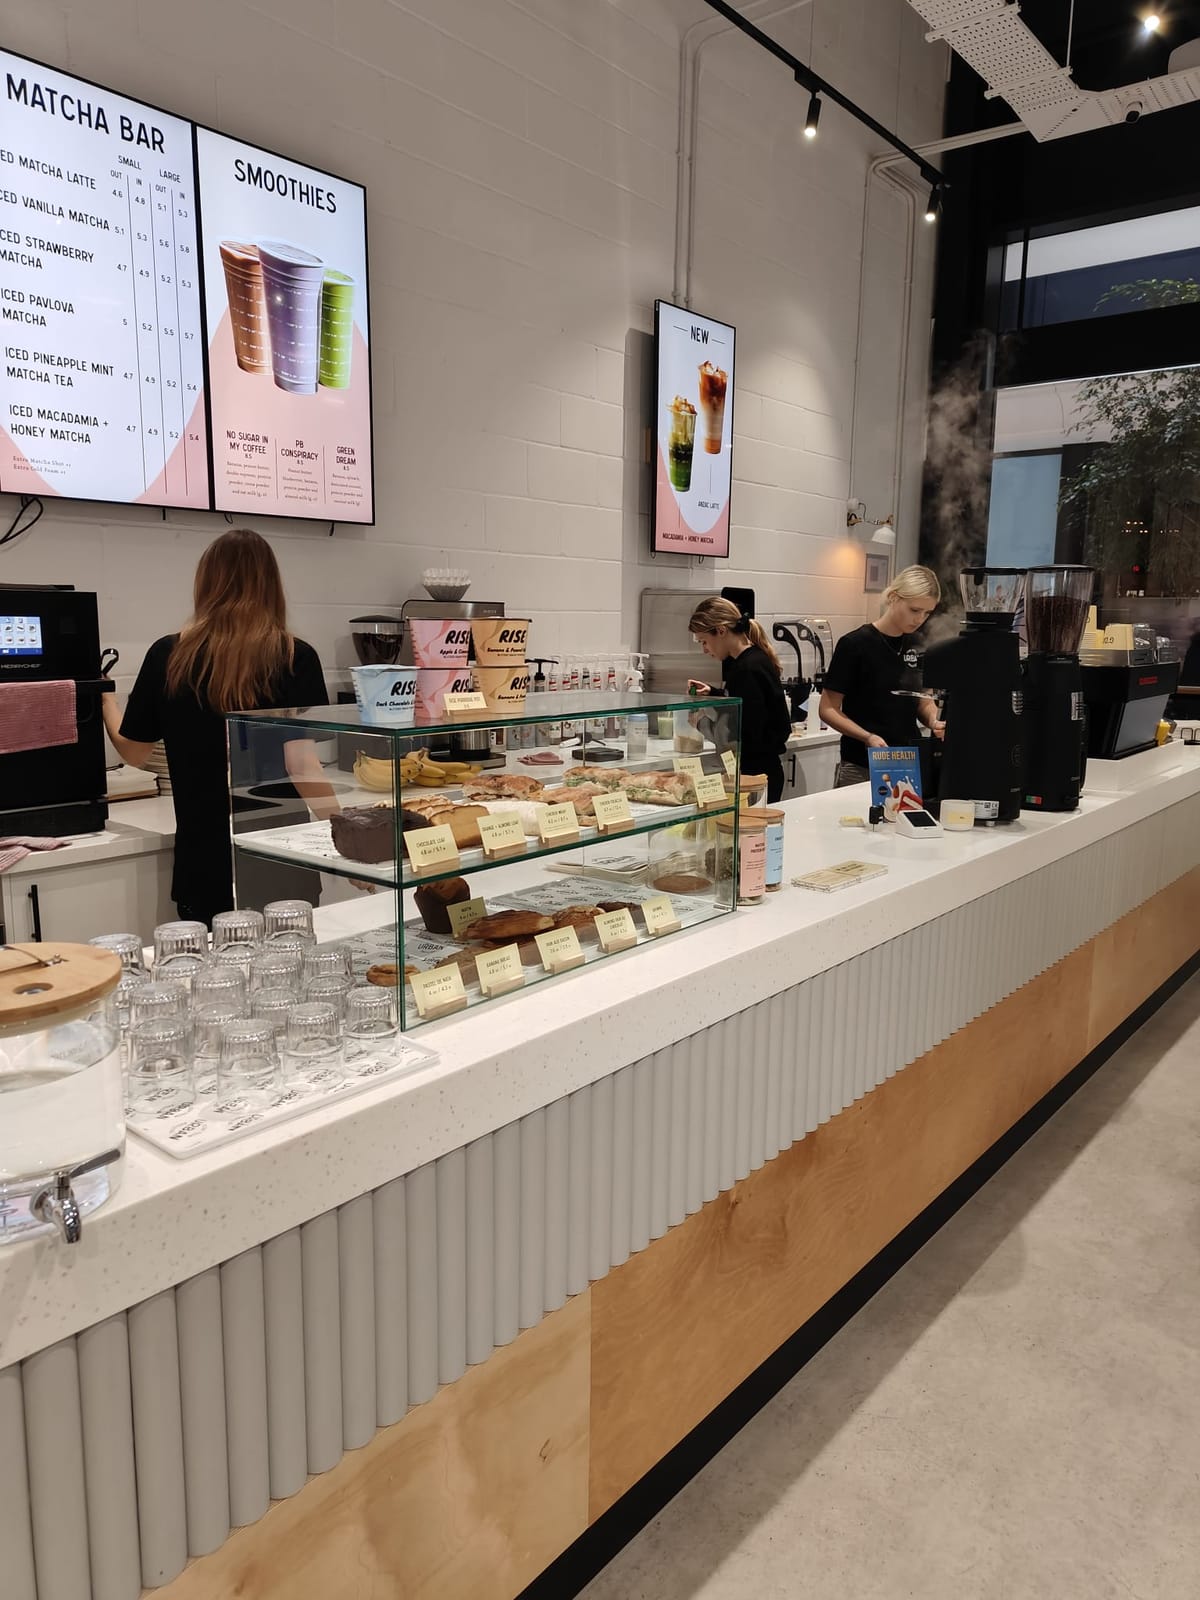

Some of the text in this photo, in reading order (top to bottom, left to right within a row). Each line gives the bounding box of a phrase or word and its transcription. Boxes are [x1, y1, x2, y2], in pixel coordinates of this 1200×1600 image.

[6, 73, 165, 154] MATCHA BAR
[19, 156, 63, 180] MATCHA
[67, 170, 96, 190] LATTE
[118, 155, 181, 183] SMALL LARGE
[110, 170, 185, 200] OUT IN OUT IN
[234, 158, 336, 213] SMOOTHIES
[22, 195, 65, 218] VANILLA
[69, 209, 109, 231] MATCHA
[158, 203, 167, 212] 5.1
[115, 226, 125, 235] 5.1
[0, 249, 42, 269] MATCHA
[25, 236, 94, 263] STRAWBERRY
[117, 264, 127, 272] 4.7
[1, 288, 74, 314] ICED PAVLOVA
[2, 308, 47, 327] MATCHA
[142, 323, 152, 331] 5.2
[184, 332, 194, 340] 5.7
[690, 326, 710, 344] NEW
[5, 346, 114, 377] ICED PINEAPPLE MINT
[7, 366, 74, 388] MATCHA TEA
[123, 372, 133, 380] 4.7
[167, 380, 177, 388] 5.2
[187, 383, 197, 391] 5.4
[9, 404, 33, 418] ICED
[37, 408, 99, 427] MACADAMIA
[10, 423, 91, 444] HONEY MATCHA
[126, 425, 136, 433] 4.7
[169, 431, 179, 439] 5.2
[189, 433, 199, 441] 5.4
[226, 430, 269, 444] NO SUGAR IN
[229, 442, 266, 454] MY COFFEE
[295, 440, 304, 448] PB
[336, 446, 355, 456] GREEN
[281, 448, 319, 461] CONSPIRACY
[336, 455, 356, 465] DREAM
[499, 630, 527, 644] RISE
[872, 751, 916, 760] RUDE HEALTH
